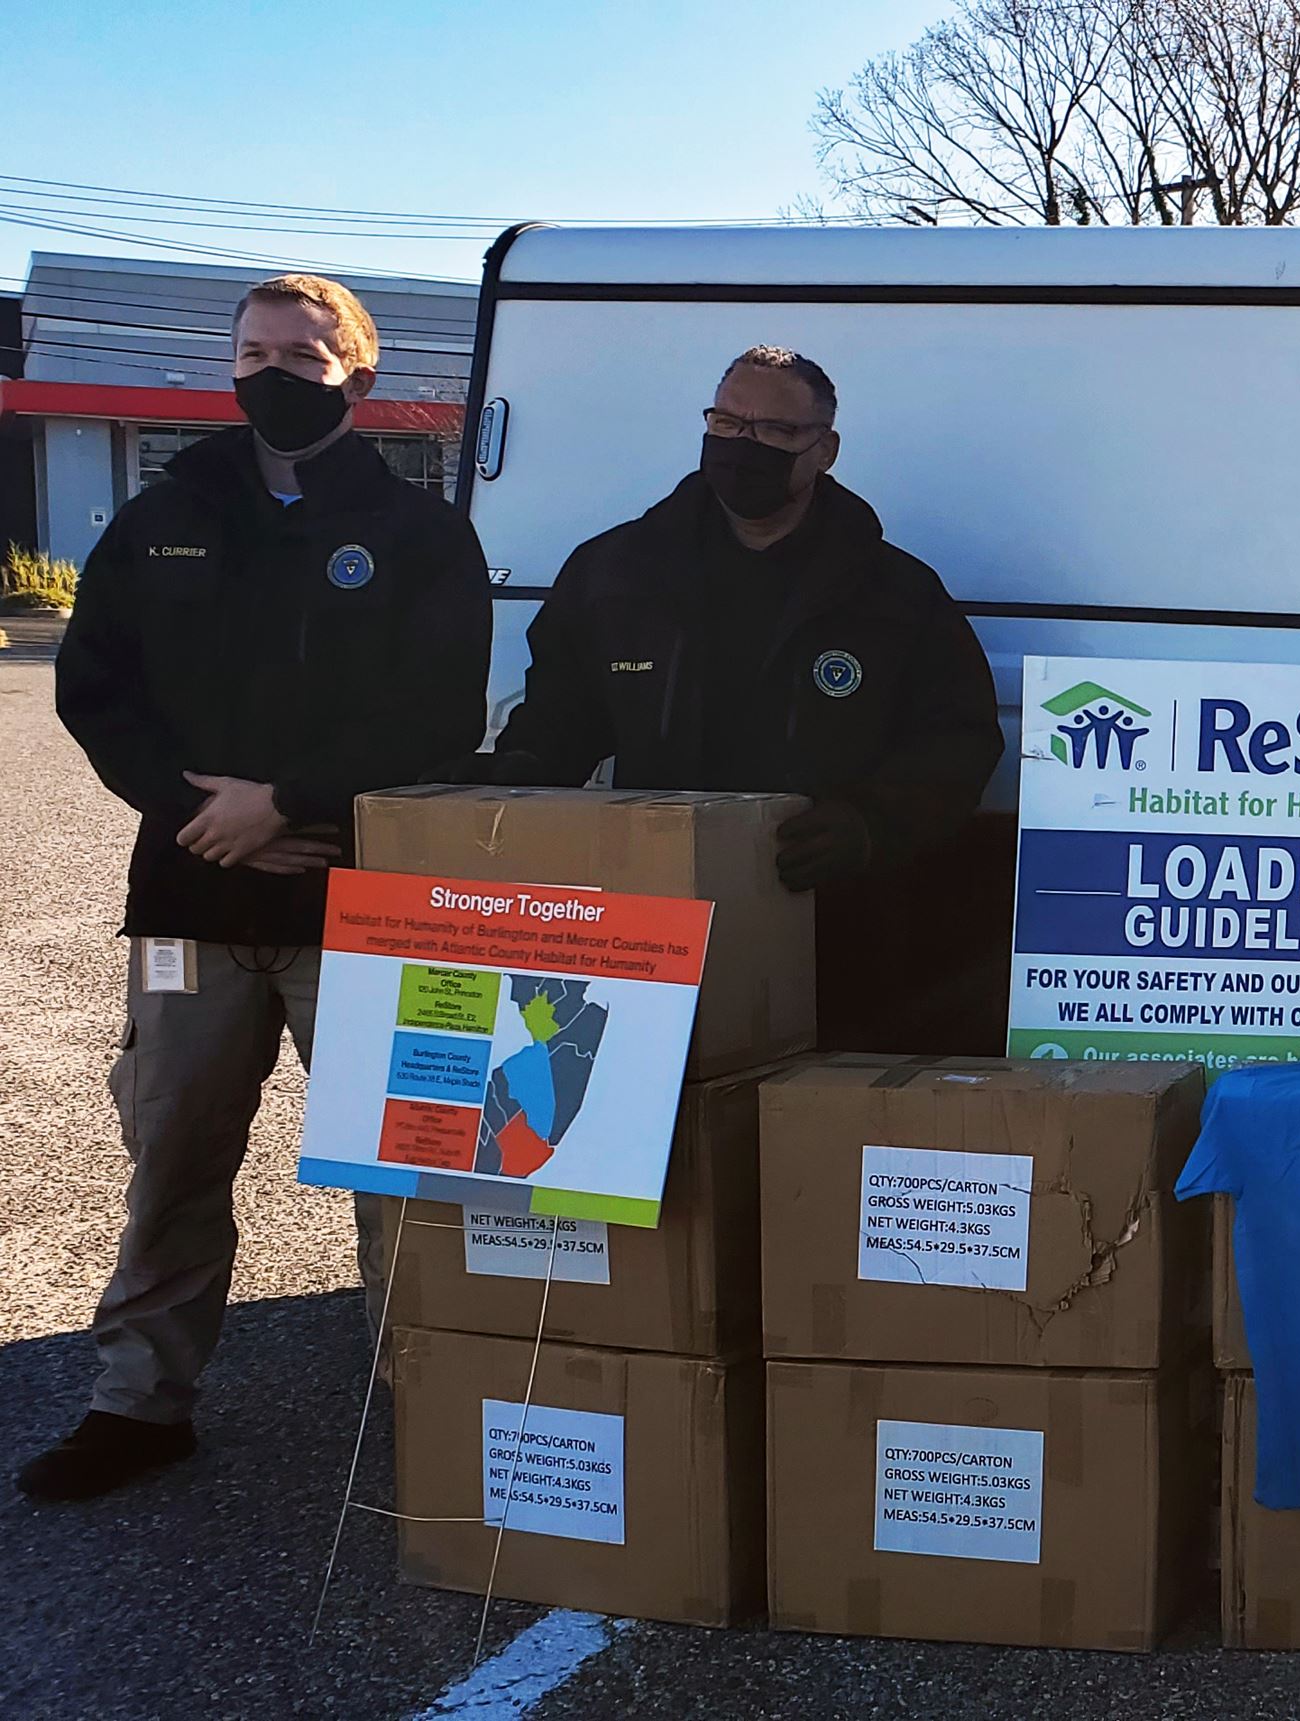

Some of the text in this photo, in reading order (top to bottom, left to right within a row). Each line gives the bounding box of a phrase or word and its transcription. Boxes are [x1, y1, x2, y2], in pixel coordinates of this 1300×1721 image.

[162, 546, 207, 557] CURRIER
[1128, 786, 1229, 815] Habitat
[1238, 790, 1277, 817] for
[430, 886, 605, 922] Stronger Together
[340, 911, 689, 957] Habitat for Humanity of Burlington and Mercer Counties has
[366, 935, 657, 975] merged with Atlantic County Habitat for Humanity
[1026, 968, 1067, 989] FOR
[1073, 969, 1130, 990] YOUR
[1137, 970, 1217, 992] SAFETY
[1220, 973, 1264, 993] AND
[1058, 1002, 1089, 1022] WE
[1095, 1003, 1133, 1023] ALL
[1140, 1004, 1225, 1026] COMPLY
[1231, 1006, 1284, 1027] WITH
[869, 1174, 998, 1195] QTY:700PCS/CARTON
[868, 1195, 1016, 1217] GROSS WEIGHT:5.03KGS
[470, 1213, 491, 1226] NET
[867, 1216, 991, 1236] NET WEIGHT:4.3KGS
[489, 1448, 611, 1474] GROSS WEIGHT:5.03KGS
[885, 1448, 1013, 1469] QTY:700PCS/CARTON
[489, 1468, 591, 1492] NET WEIGHT:4.3KGS
[884, 1468, 1031, 1490] GROSS WEIGHT:5.03KGS
[884, 1488, 1006, 1509] NET WEIGHT:4.3KGS
